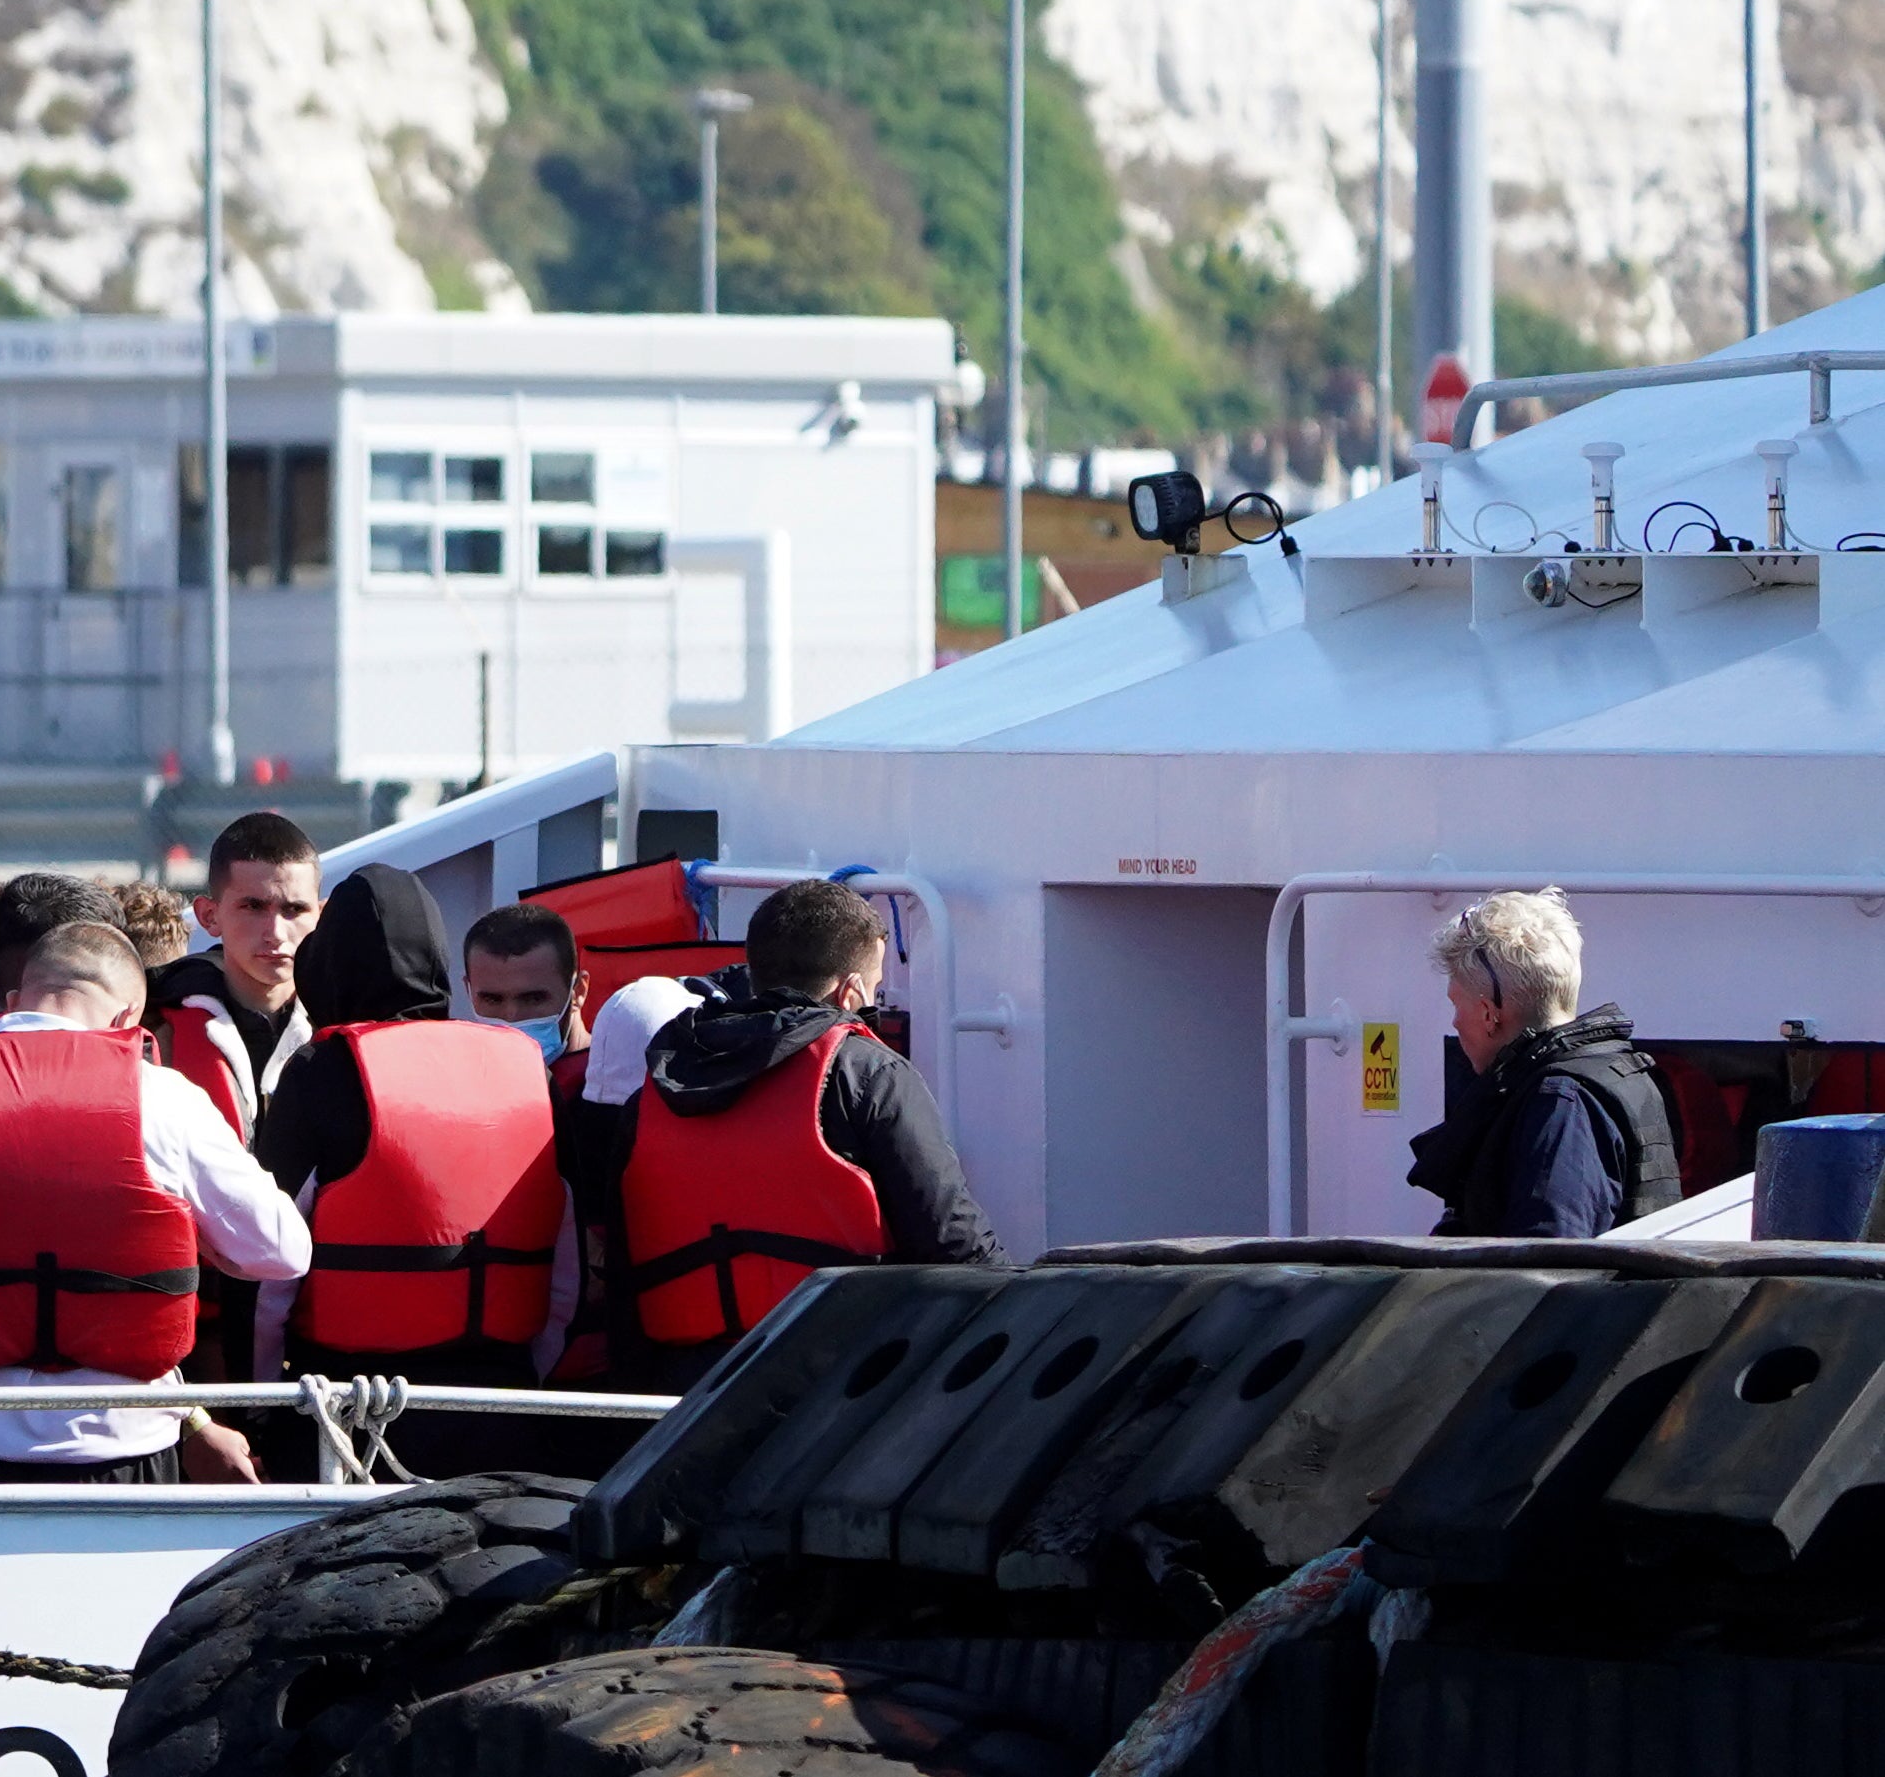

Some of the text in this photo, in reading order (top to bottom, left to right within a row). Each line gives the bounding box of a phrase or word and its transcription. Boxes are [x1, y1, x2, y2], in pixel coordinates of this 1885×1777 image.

[1119, 858, 1197, 874] MIND YOUR HEAD
[1365, 1067, 1397, 1089] CCTV
